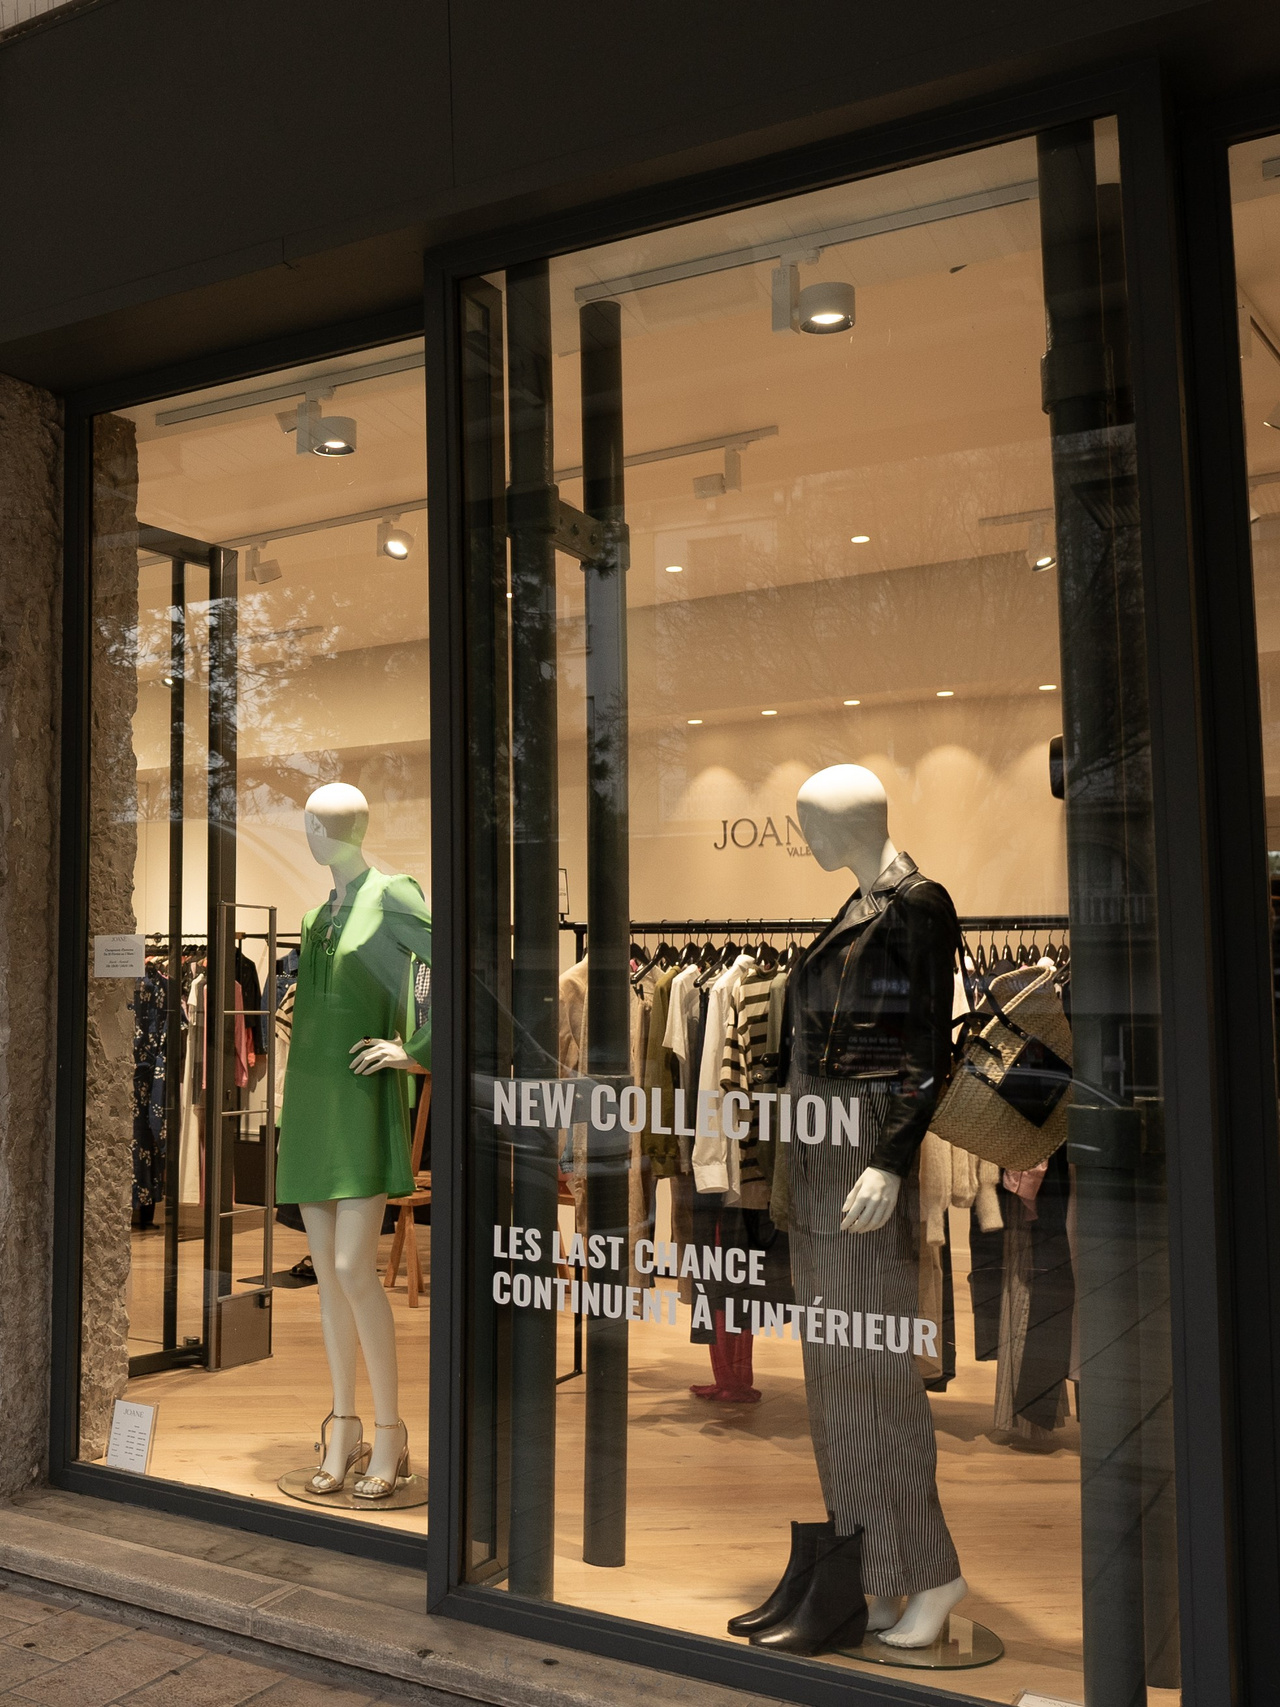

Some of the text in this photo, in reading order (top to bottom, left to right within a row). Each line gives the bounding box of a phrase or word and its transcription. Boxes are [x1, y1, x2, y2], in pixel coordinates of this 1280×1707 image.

[493, 1080, 860, 1147] NEW COLLECTION
[493, 1225, 766, 1286] LES LAST CHANCE
[492, 1270, 938, 1358] CONTINUENT À L'INTÉRIEUR
[123, 1408, 144, 1418] JOANE
